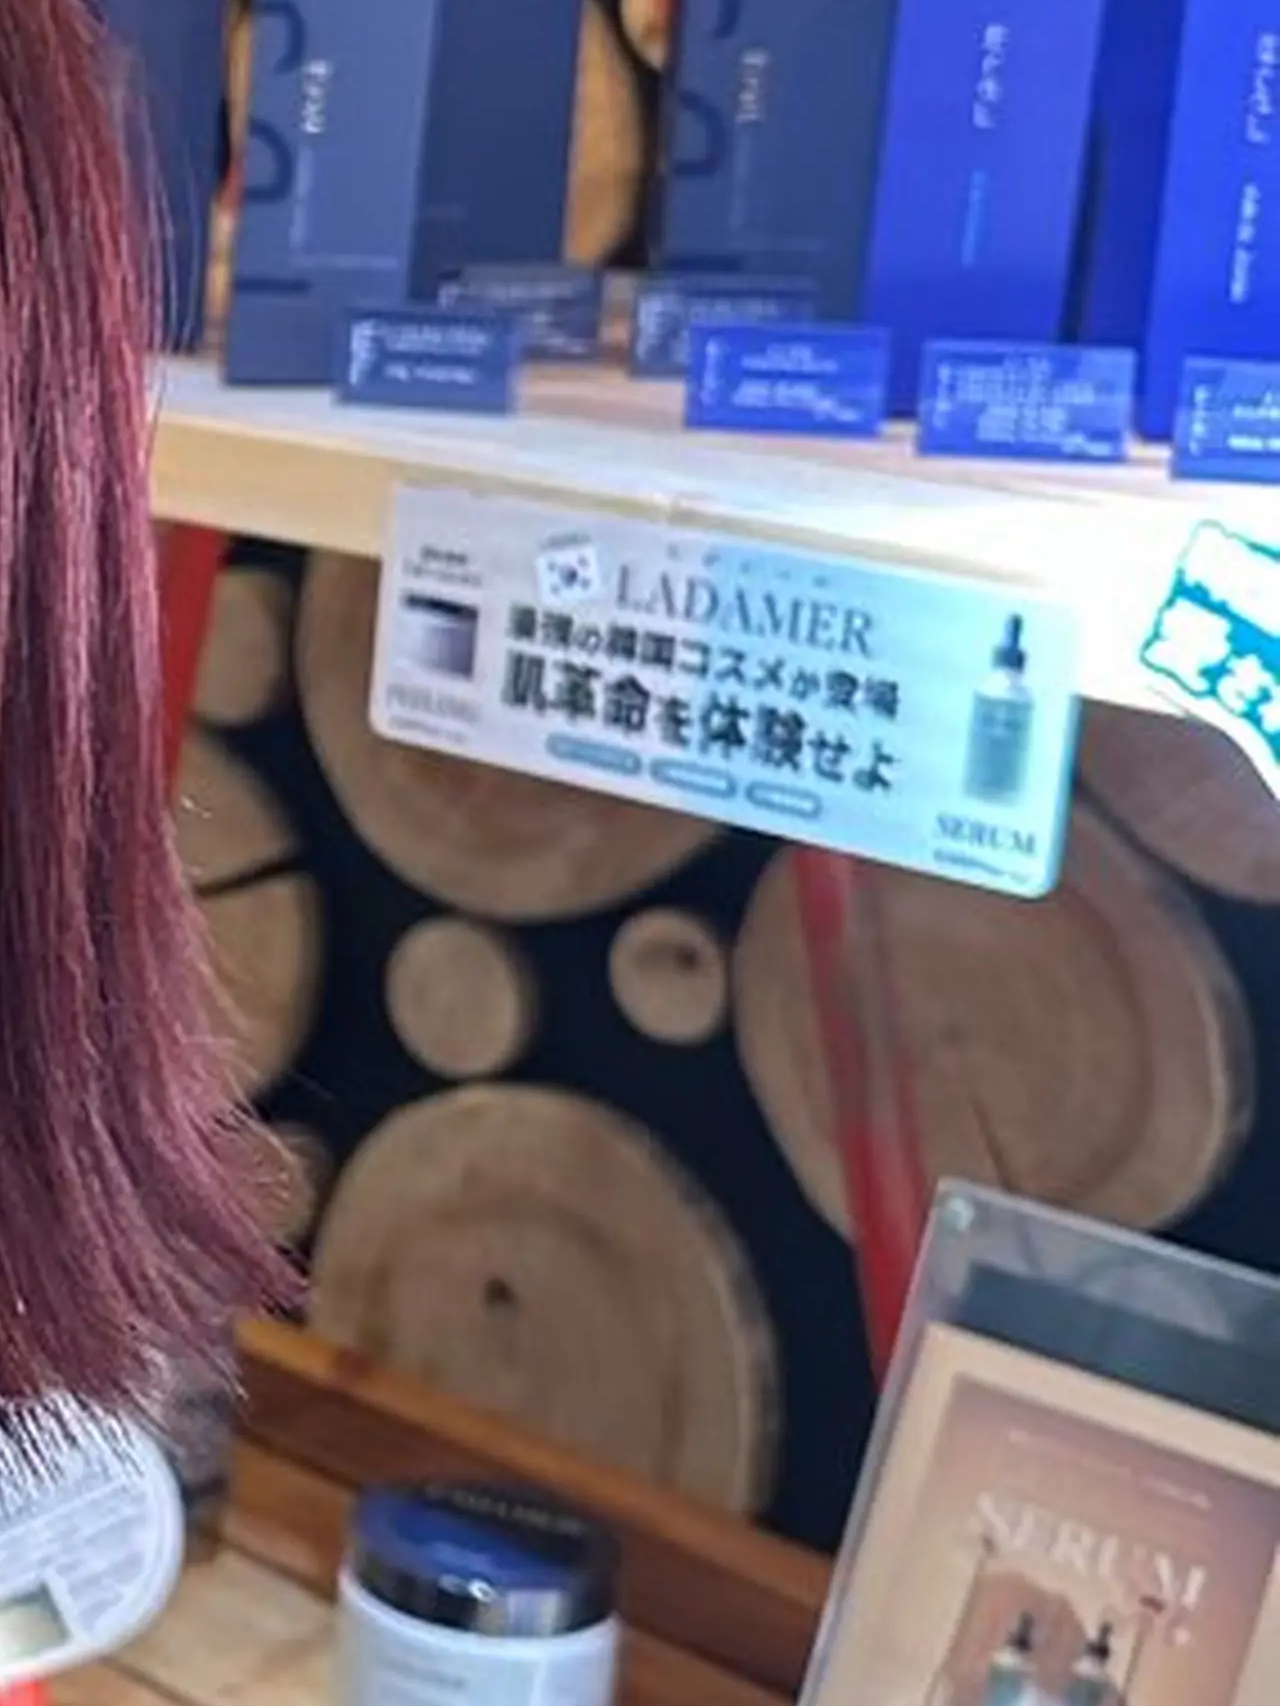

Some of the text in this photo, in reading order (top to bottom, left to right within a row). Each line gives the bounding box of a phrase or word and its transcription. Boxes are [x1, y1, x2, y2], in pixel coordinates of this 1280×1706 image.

[615, 564, 876, 659] LADAMER
[501, 648, 903, 794] 肌革命を体験せよ
[933, 813, 1038, 856] SERUM
